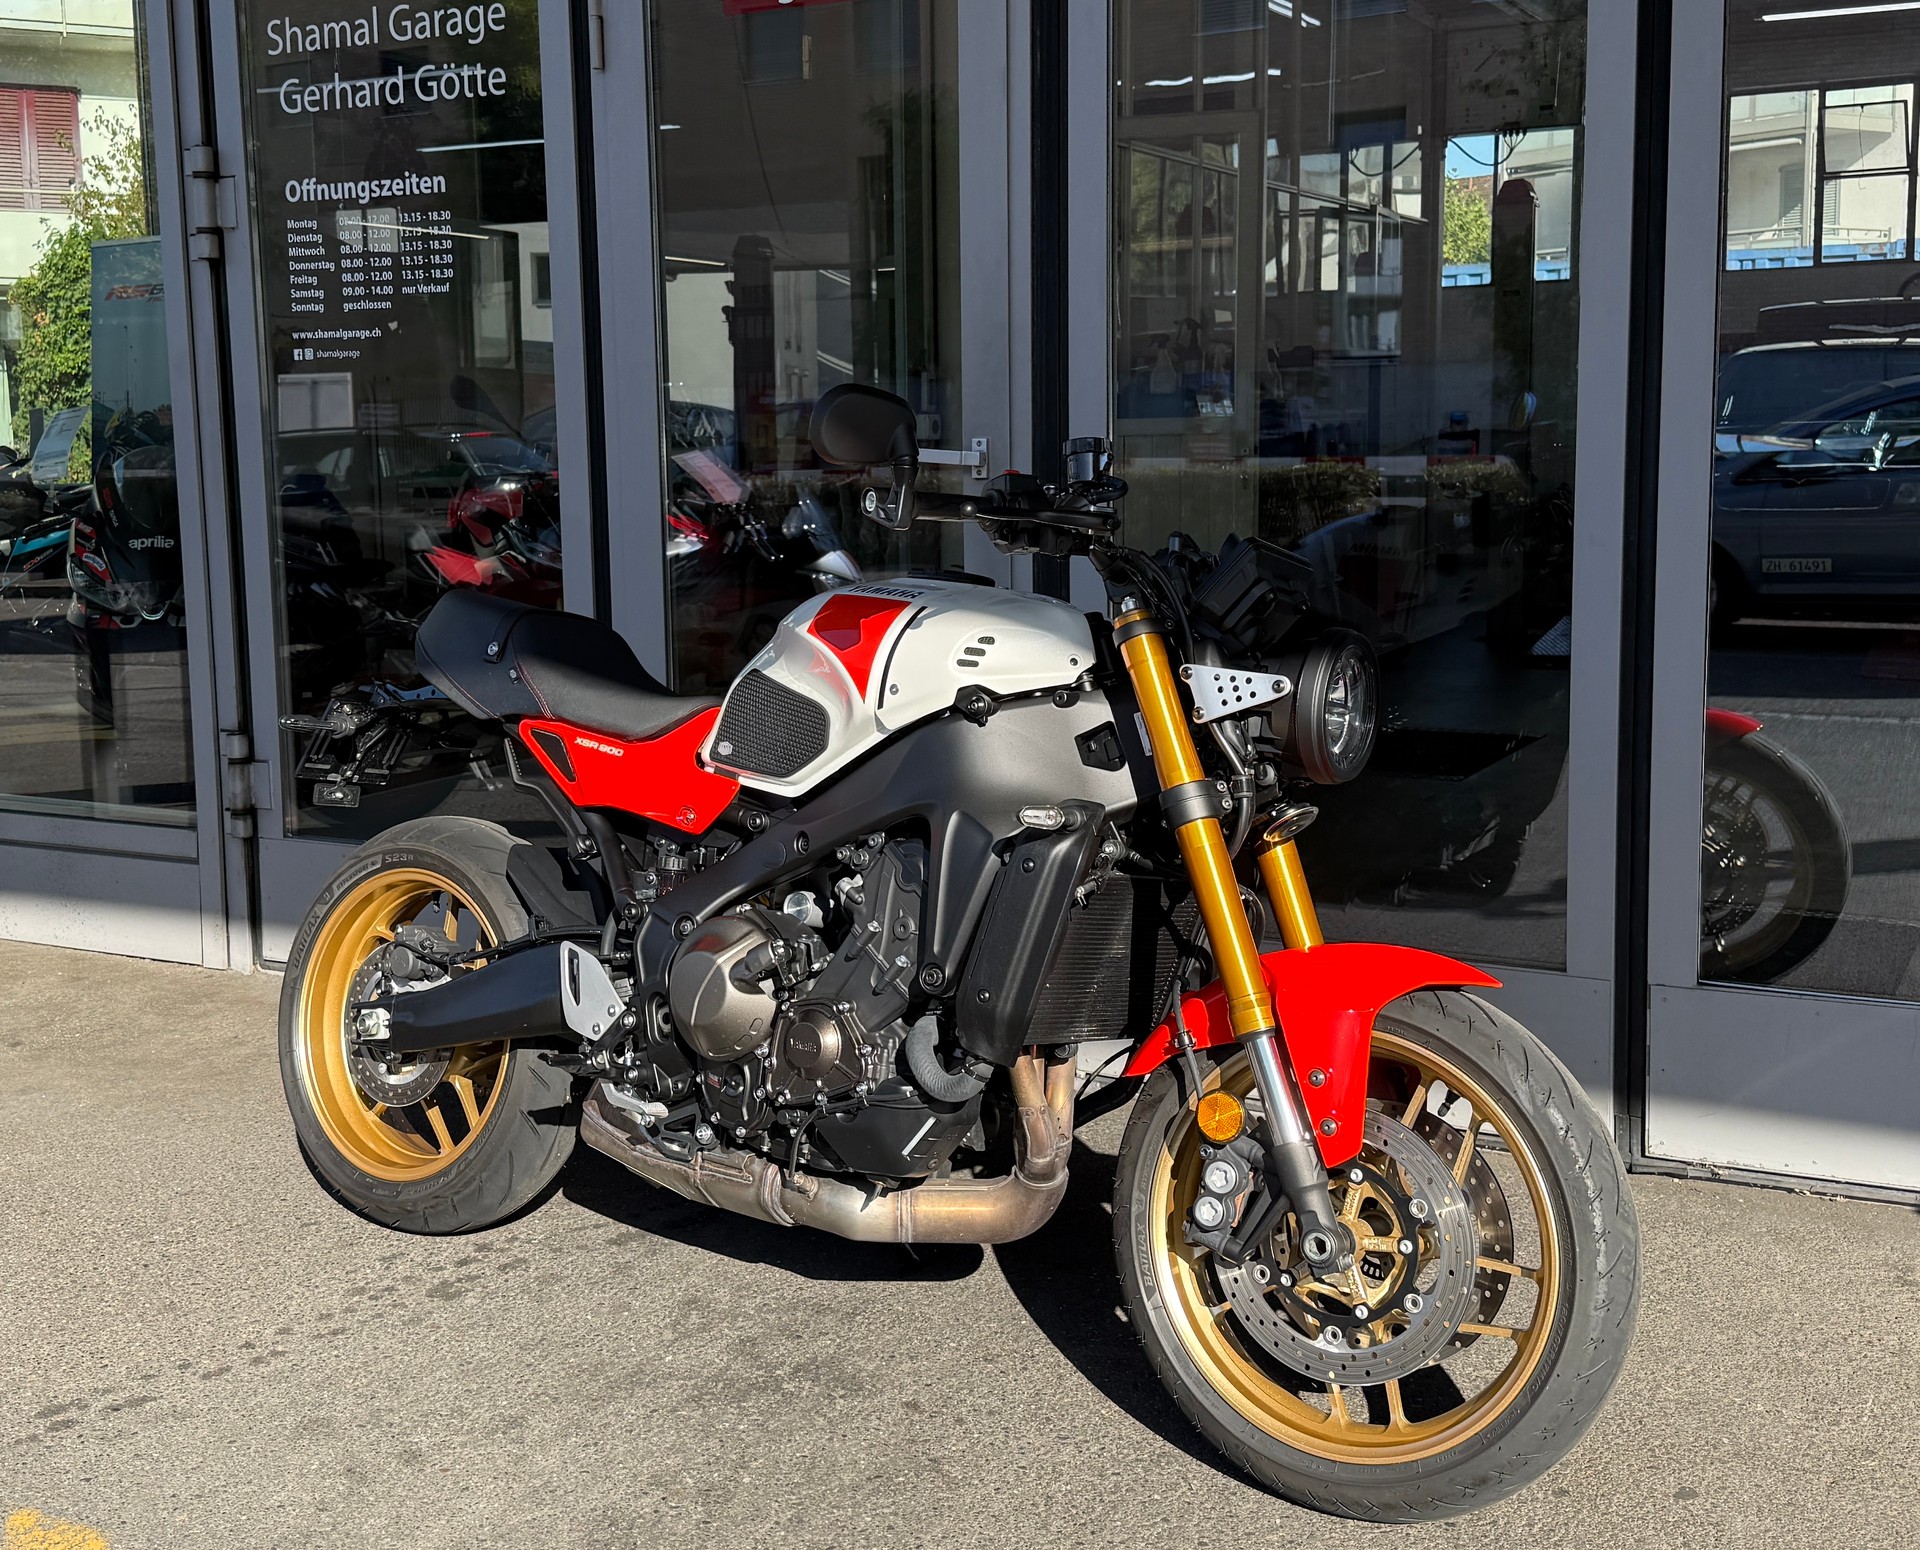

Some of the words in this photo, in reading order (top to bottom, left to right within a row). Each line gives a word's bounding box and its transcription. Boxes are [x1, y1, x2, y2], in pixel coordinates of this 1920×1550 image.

[266, 6, 379, 56] Shamal
[388, 2, 506, 45] Garage
[279, 65, 405, 114] Gerhard
[414, 62, 507, 102] Götte
[287, 219, 317, 230] Montag
[368, 215, 389, 223] 12.00
[400, 213, 421, 222] 13.15
[428, 211, 450, 220] 18.30
[288, 233, 323, 244] Dienstag
[340, 232, 362, 240] 08.00
[369, 230, 390, 238] 12.00
[289, 246, 325, 257] Mittwoch
[340, 245, 362, 254] 08.00
[369, 243, 391, 252] 12.00
[401, 242, 422, 251] 13.15
[429, 240, 452, 250] 18.30
[289, 261, 335, 271] Donnerstag
[341, 259, 363, 268] 08.00
[370, 257, 392, 266] 12.00
[401, 256, 423, 265] 13.15
[430, 254, 453, 264] 18.30
[290, 275, 318, 285] Freitag
[342, 273, 364, 282] 08.00
[371, 272, 393, 281] 12.00
[402, 270, 424, 279] 13.15
[431, 269, 453, 278] 18.30
[291, 289, 324, 299] Samstag
[343, 287, 365, 296] 09.00
[371, 286, 393, 295] 14.00
[402, 286, 416, 294] nur
[417, 282, 450, 293] Verkauf
[291, 303, 324, 313] Sonntag
[343, 300, 391, 312] geschlossen
[292, 328, 382, 340] www.shamalgarage.ch
[316, 348, 360, 359] shamalgarage
[128, 535, 174, 550] aprilia
[1766, 561, 1781, 572] ZH
[1789, 561, 1826, 572] 61491
